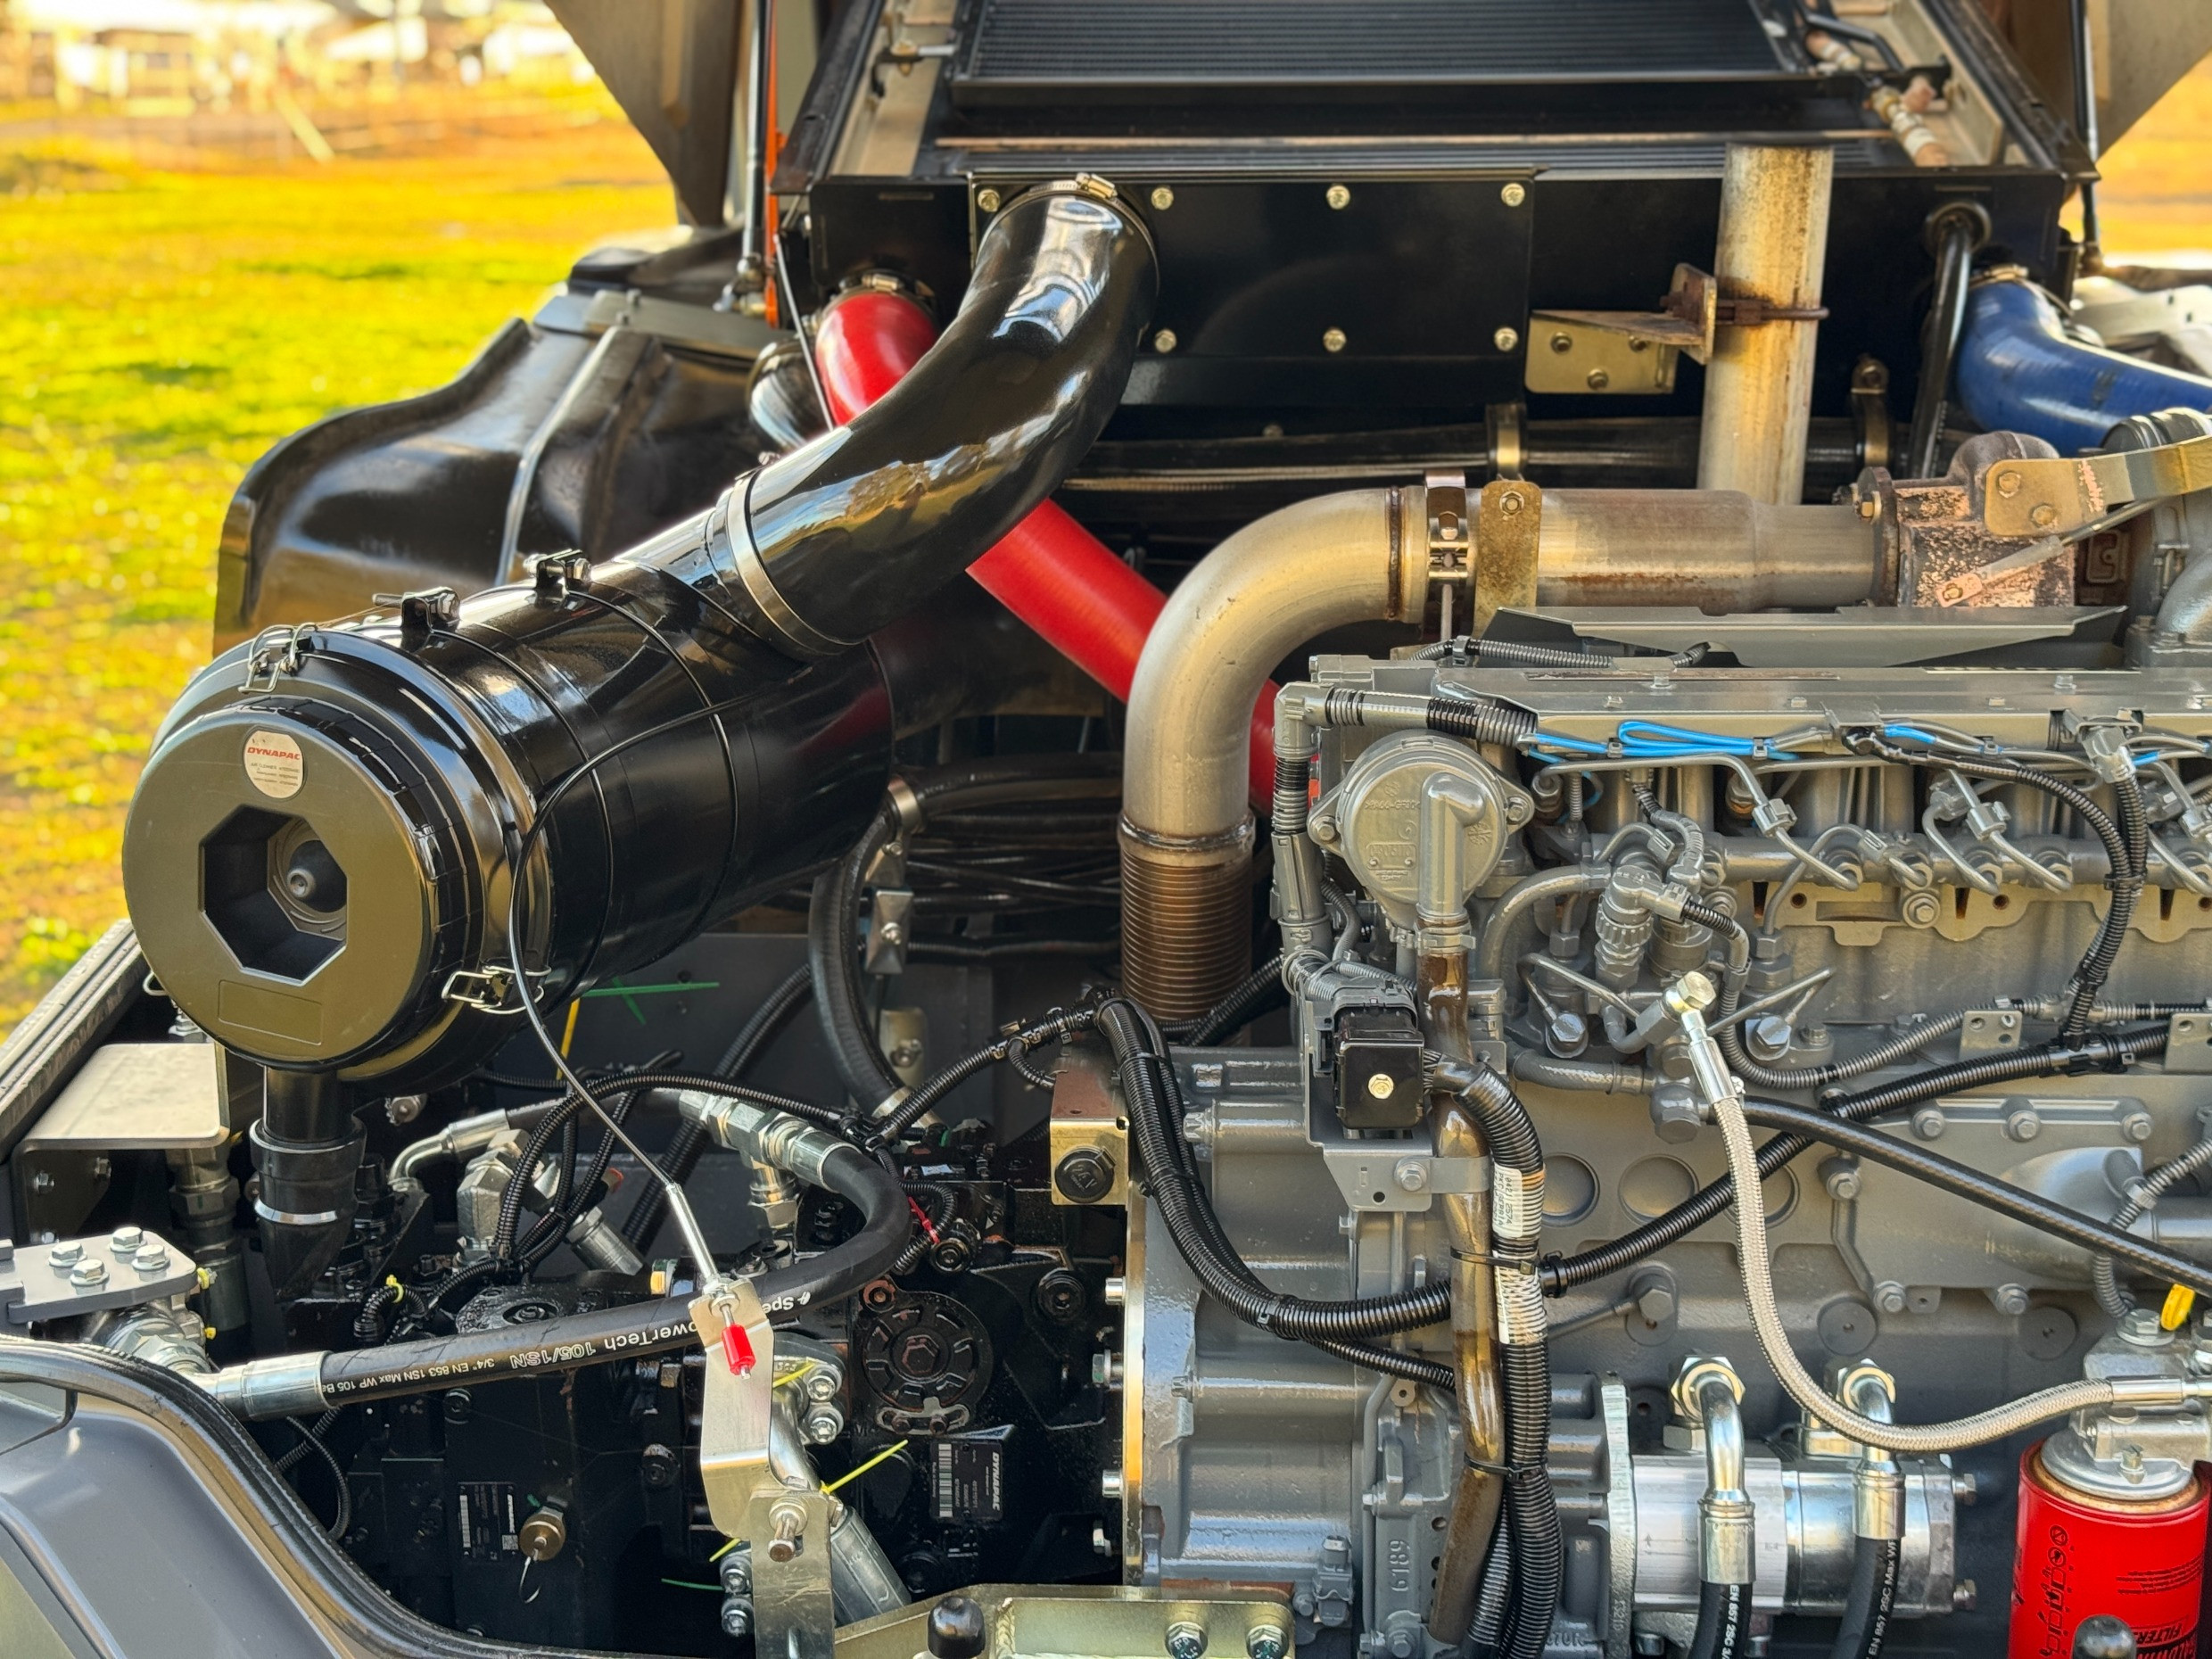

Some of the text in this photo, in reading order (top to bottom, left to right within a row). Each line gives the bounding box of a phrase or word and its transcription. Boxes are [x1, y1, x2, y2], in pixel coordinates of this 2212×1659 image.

[247, 747, 301, 760] DYNAPAC
[762, 1296, 795, 1314] Spe
[604, 1321, 698, 1351] owerTech
[509, 1341, 597, 1369] 105/1SN
[403, 1369, 425, 1381] 1SN
[428, 1366, 450, 1377] 853
[452, 1362, 469, 1374] EN
[359, 1379, 378, 1389] WP
[379, 1374, 401, 1383] Max
[322, 1383, 335, 1393] Ba
[338, 1381, 357, 1392] 105
[1884, 1559, 1895, 1586] Max
[1729, 1584, 1740, 1602] EN
[1879, 1587, 1892, 1613] 2SC
[1874, 1614, 1887, 1637] 857
[1724, 1623, 1737, 1647] 2SC
[1721, 1647, 1733, 1659] 3/
[1869, 1638, 1882, 1656] EN
